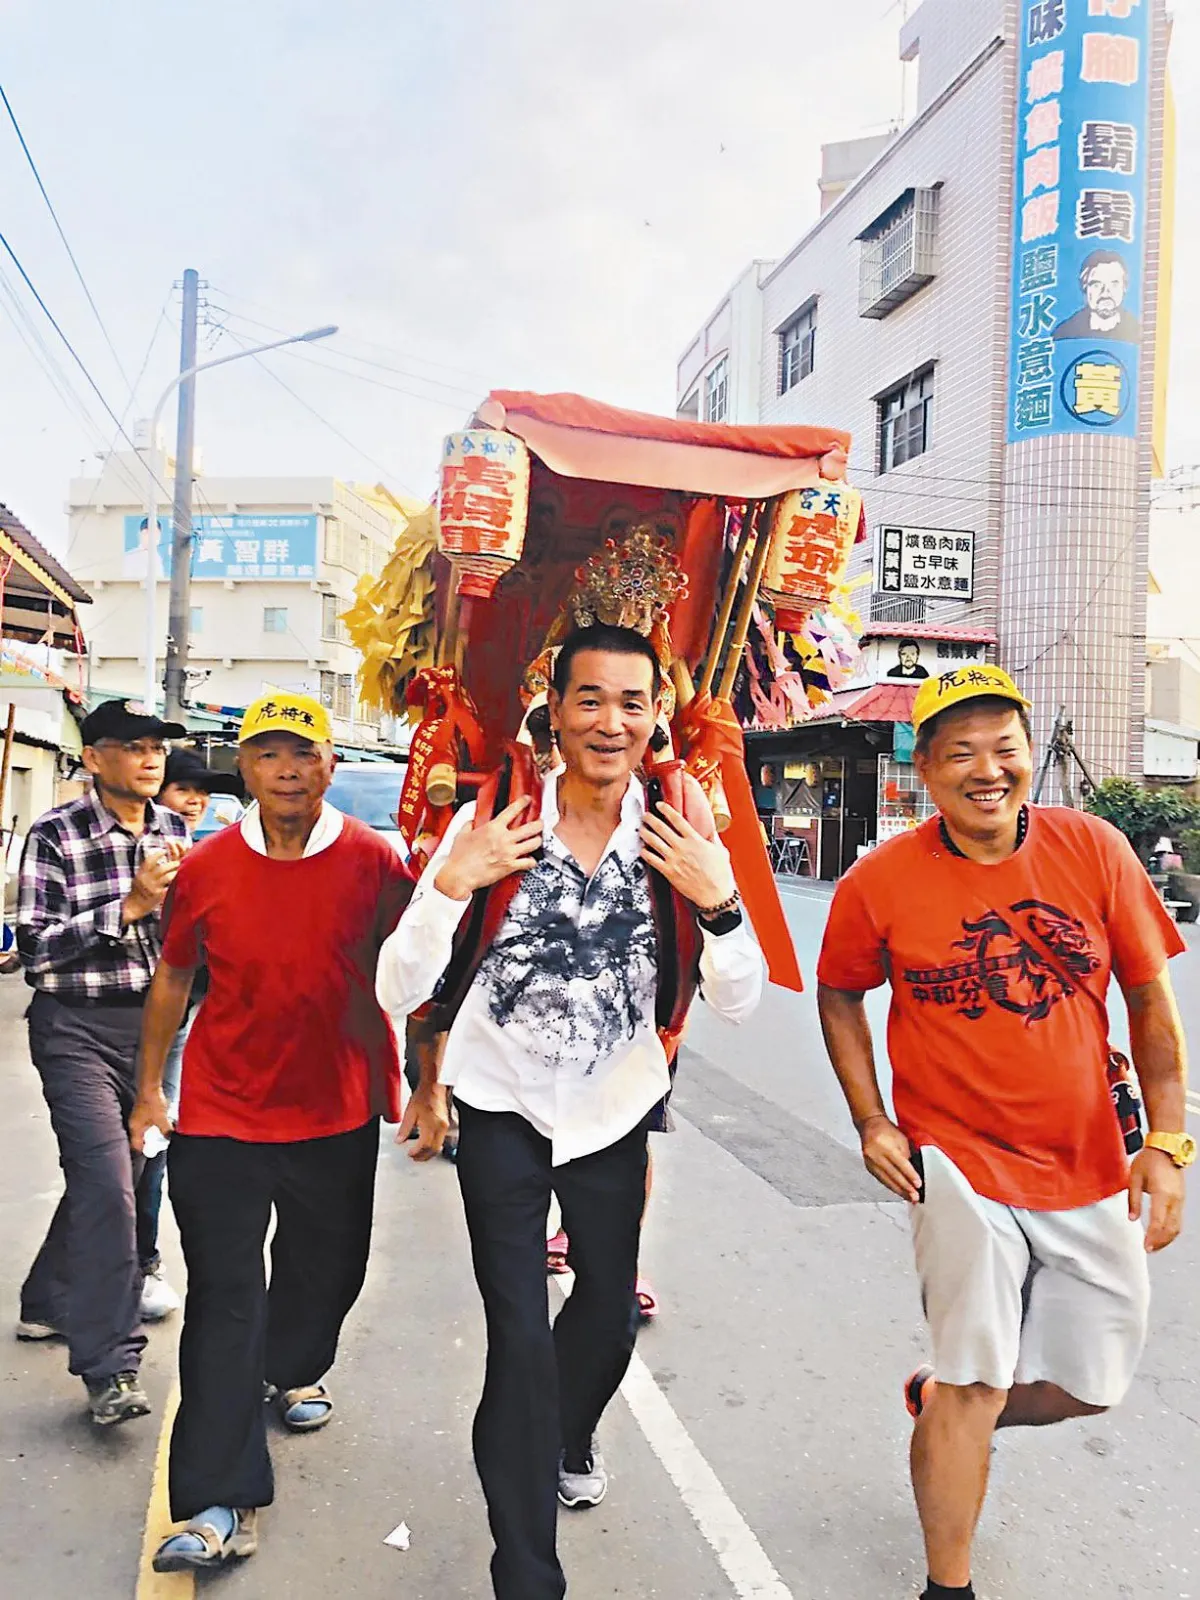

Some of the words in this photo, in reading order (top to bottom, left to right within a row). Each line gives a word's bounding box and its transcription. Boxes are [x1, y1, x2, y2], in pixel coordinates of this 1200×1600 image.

[1015, 243, 1057, 431] 鹽水意麵
[912, 554, 959, 570] 古早味
[903, 573, 970, 592] 鹽水意麵
